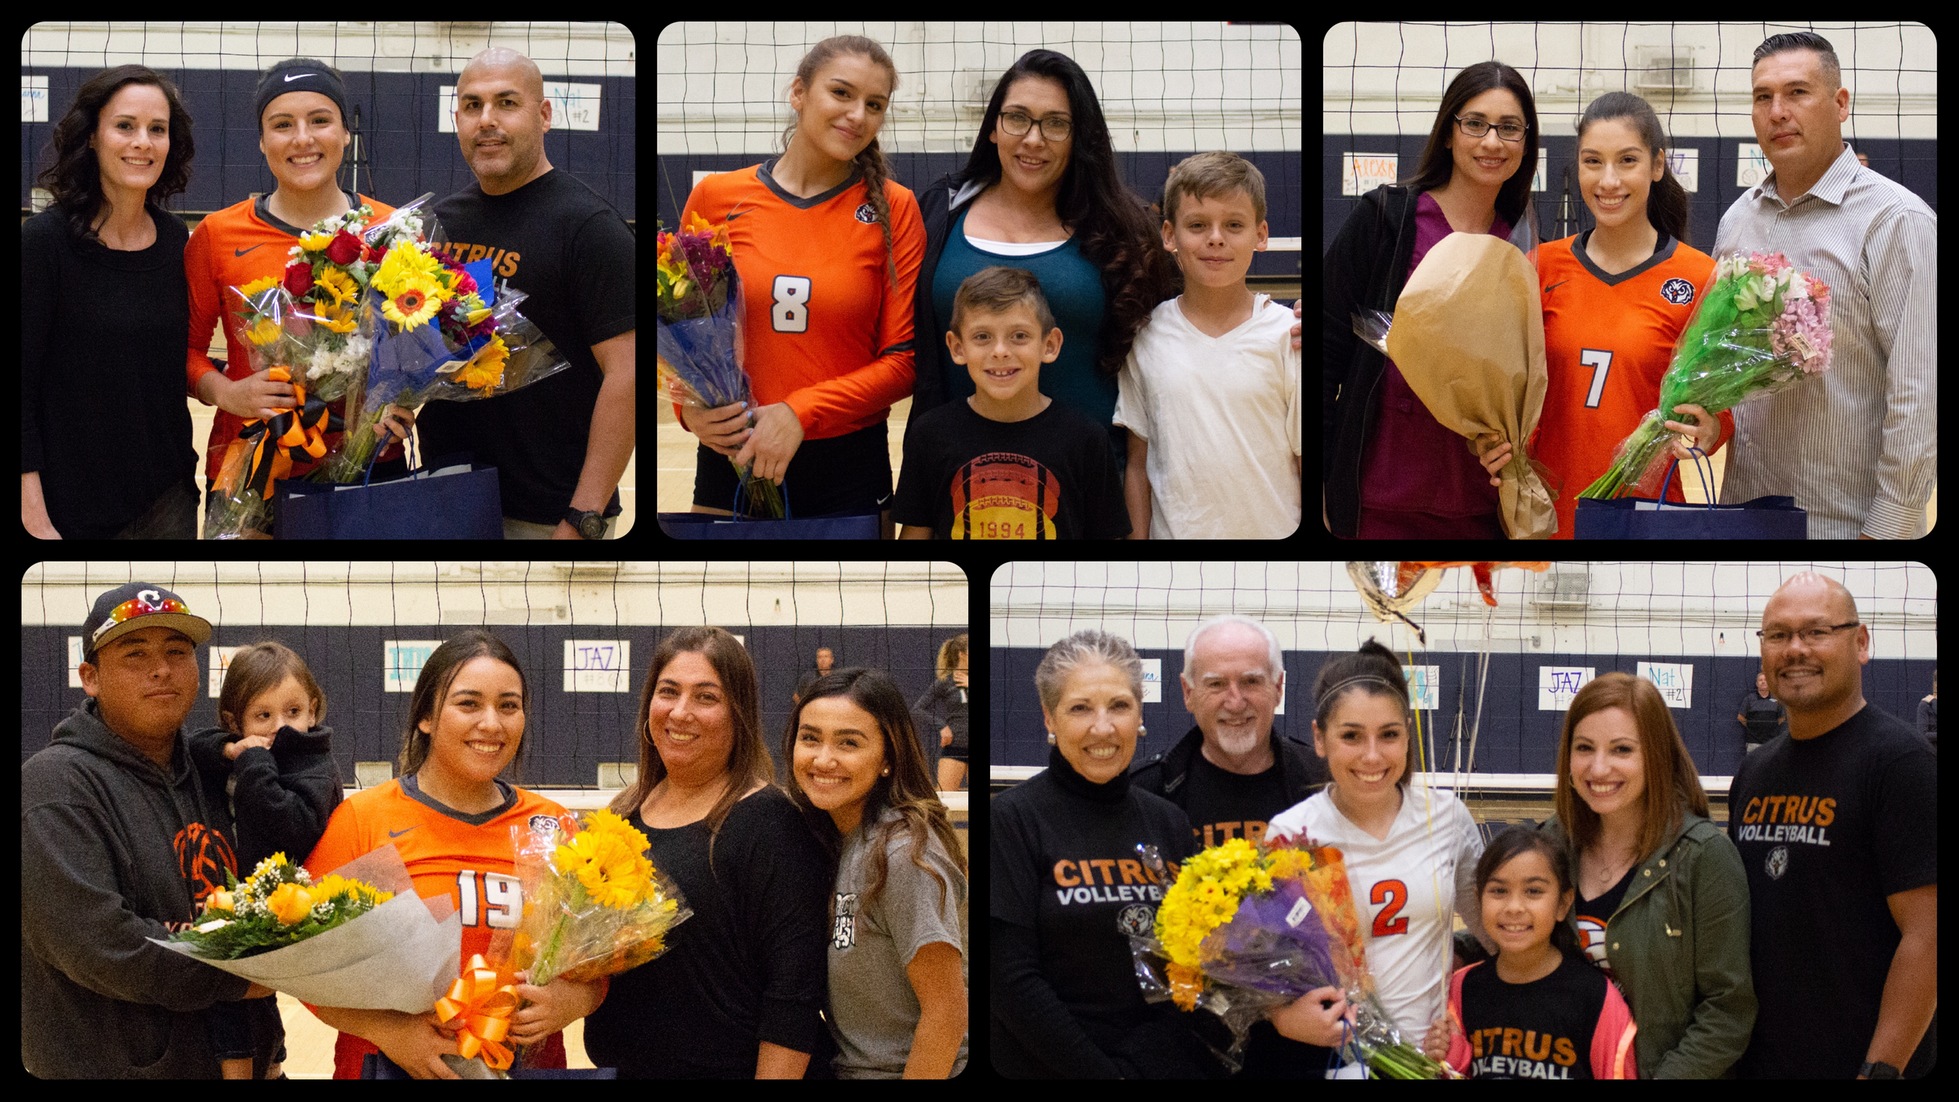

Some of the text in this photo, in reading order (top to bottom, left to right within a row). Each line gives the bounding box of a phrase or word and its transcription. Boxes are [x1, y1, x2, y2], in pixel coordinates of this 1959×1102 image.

[572, 109, 590, 124] #2
[1666, 152, 1689, 175] AZ
[771, 274, 812, 334] 8
[1580, 348, 1614, 409] 7
[979, 521, 1025, 539] 1994
[1665, 688, 1683, 702] #2
[1742, 795, 1837, 827] CITRUS
[1193, 820, 1269, 848] ITR
[1738, 824, 1831, 846] VOLLEYBALL
[457, 870, 523, 929] 19
[1056, 884, 1164, 906] VOLLEYB
[1370, 879, 1409, 938] 2
[1470, 1026, 1578, 1067] ITRUS
